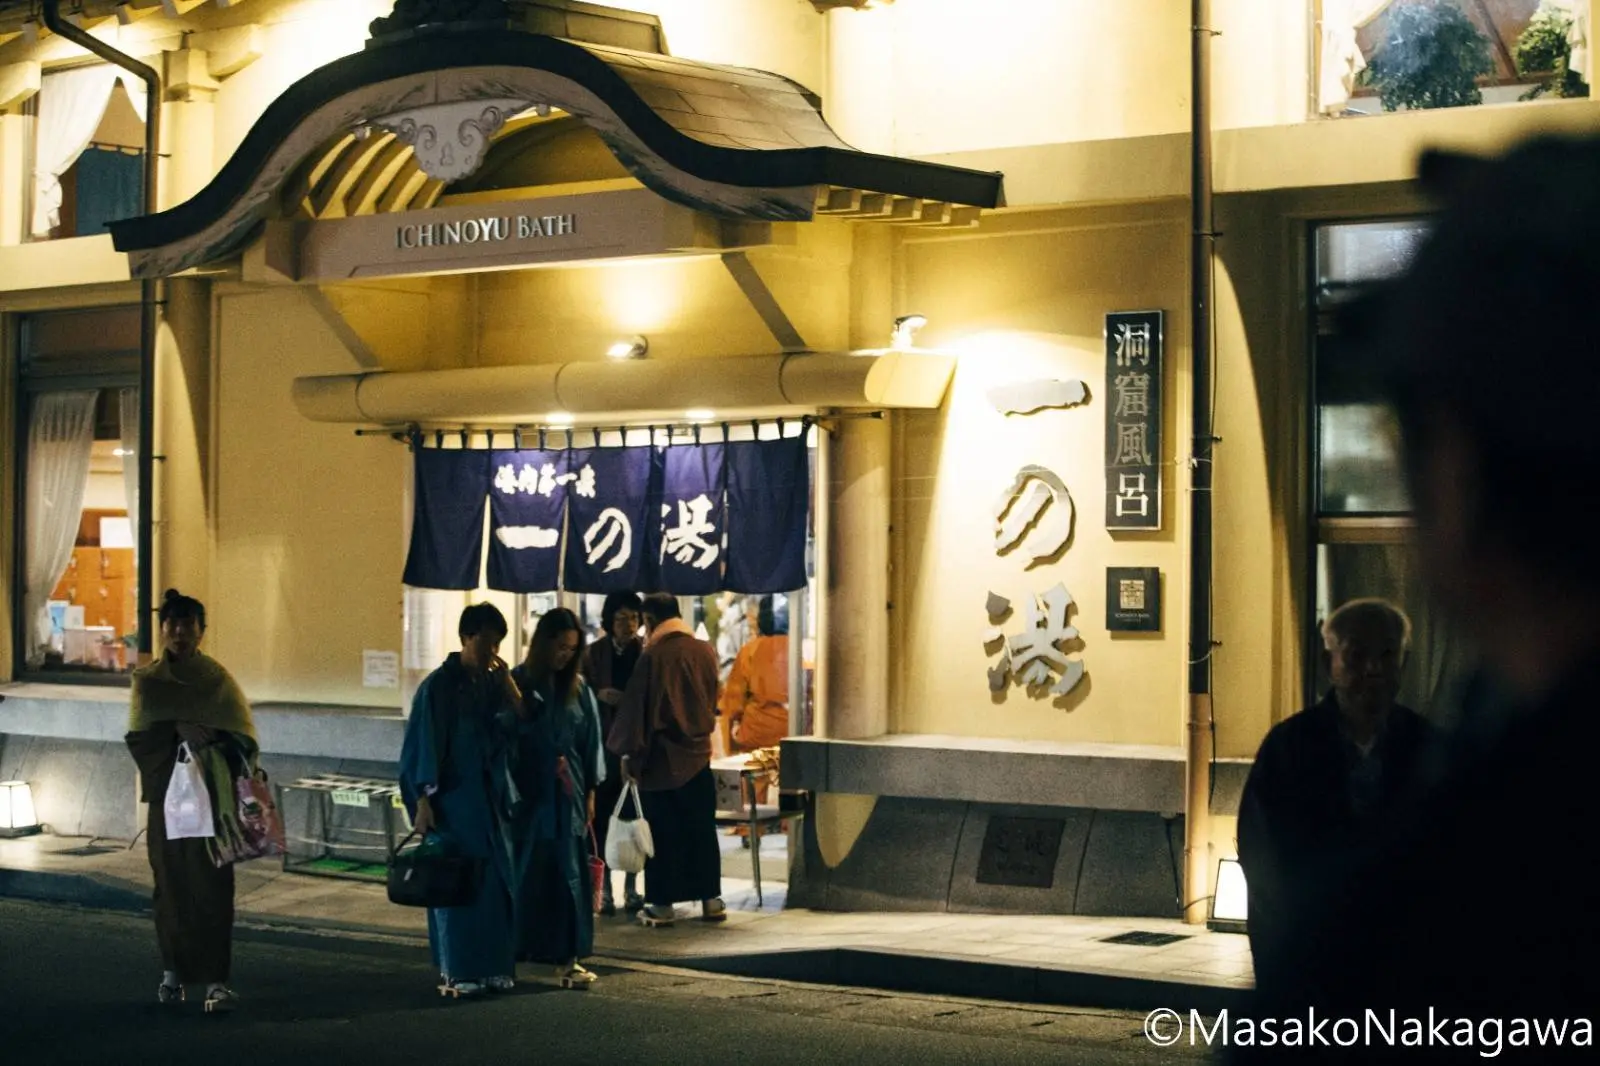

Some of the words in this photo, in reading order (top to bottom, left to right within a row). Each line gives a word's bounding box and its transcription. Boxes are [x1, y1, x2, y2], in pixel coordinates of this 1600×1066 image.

[396, 217, 510, 249] ICHINOYU
[517, 214, 576, 240] BATH
[1113, 321, 1152, 517] 洞窟風呂
[495, 493, 719, 573] 一の湯
[984, 379, 1085, 696] 一の湯
